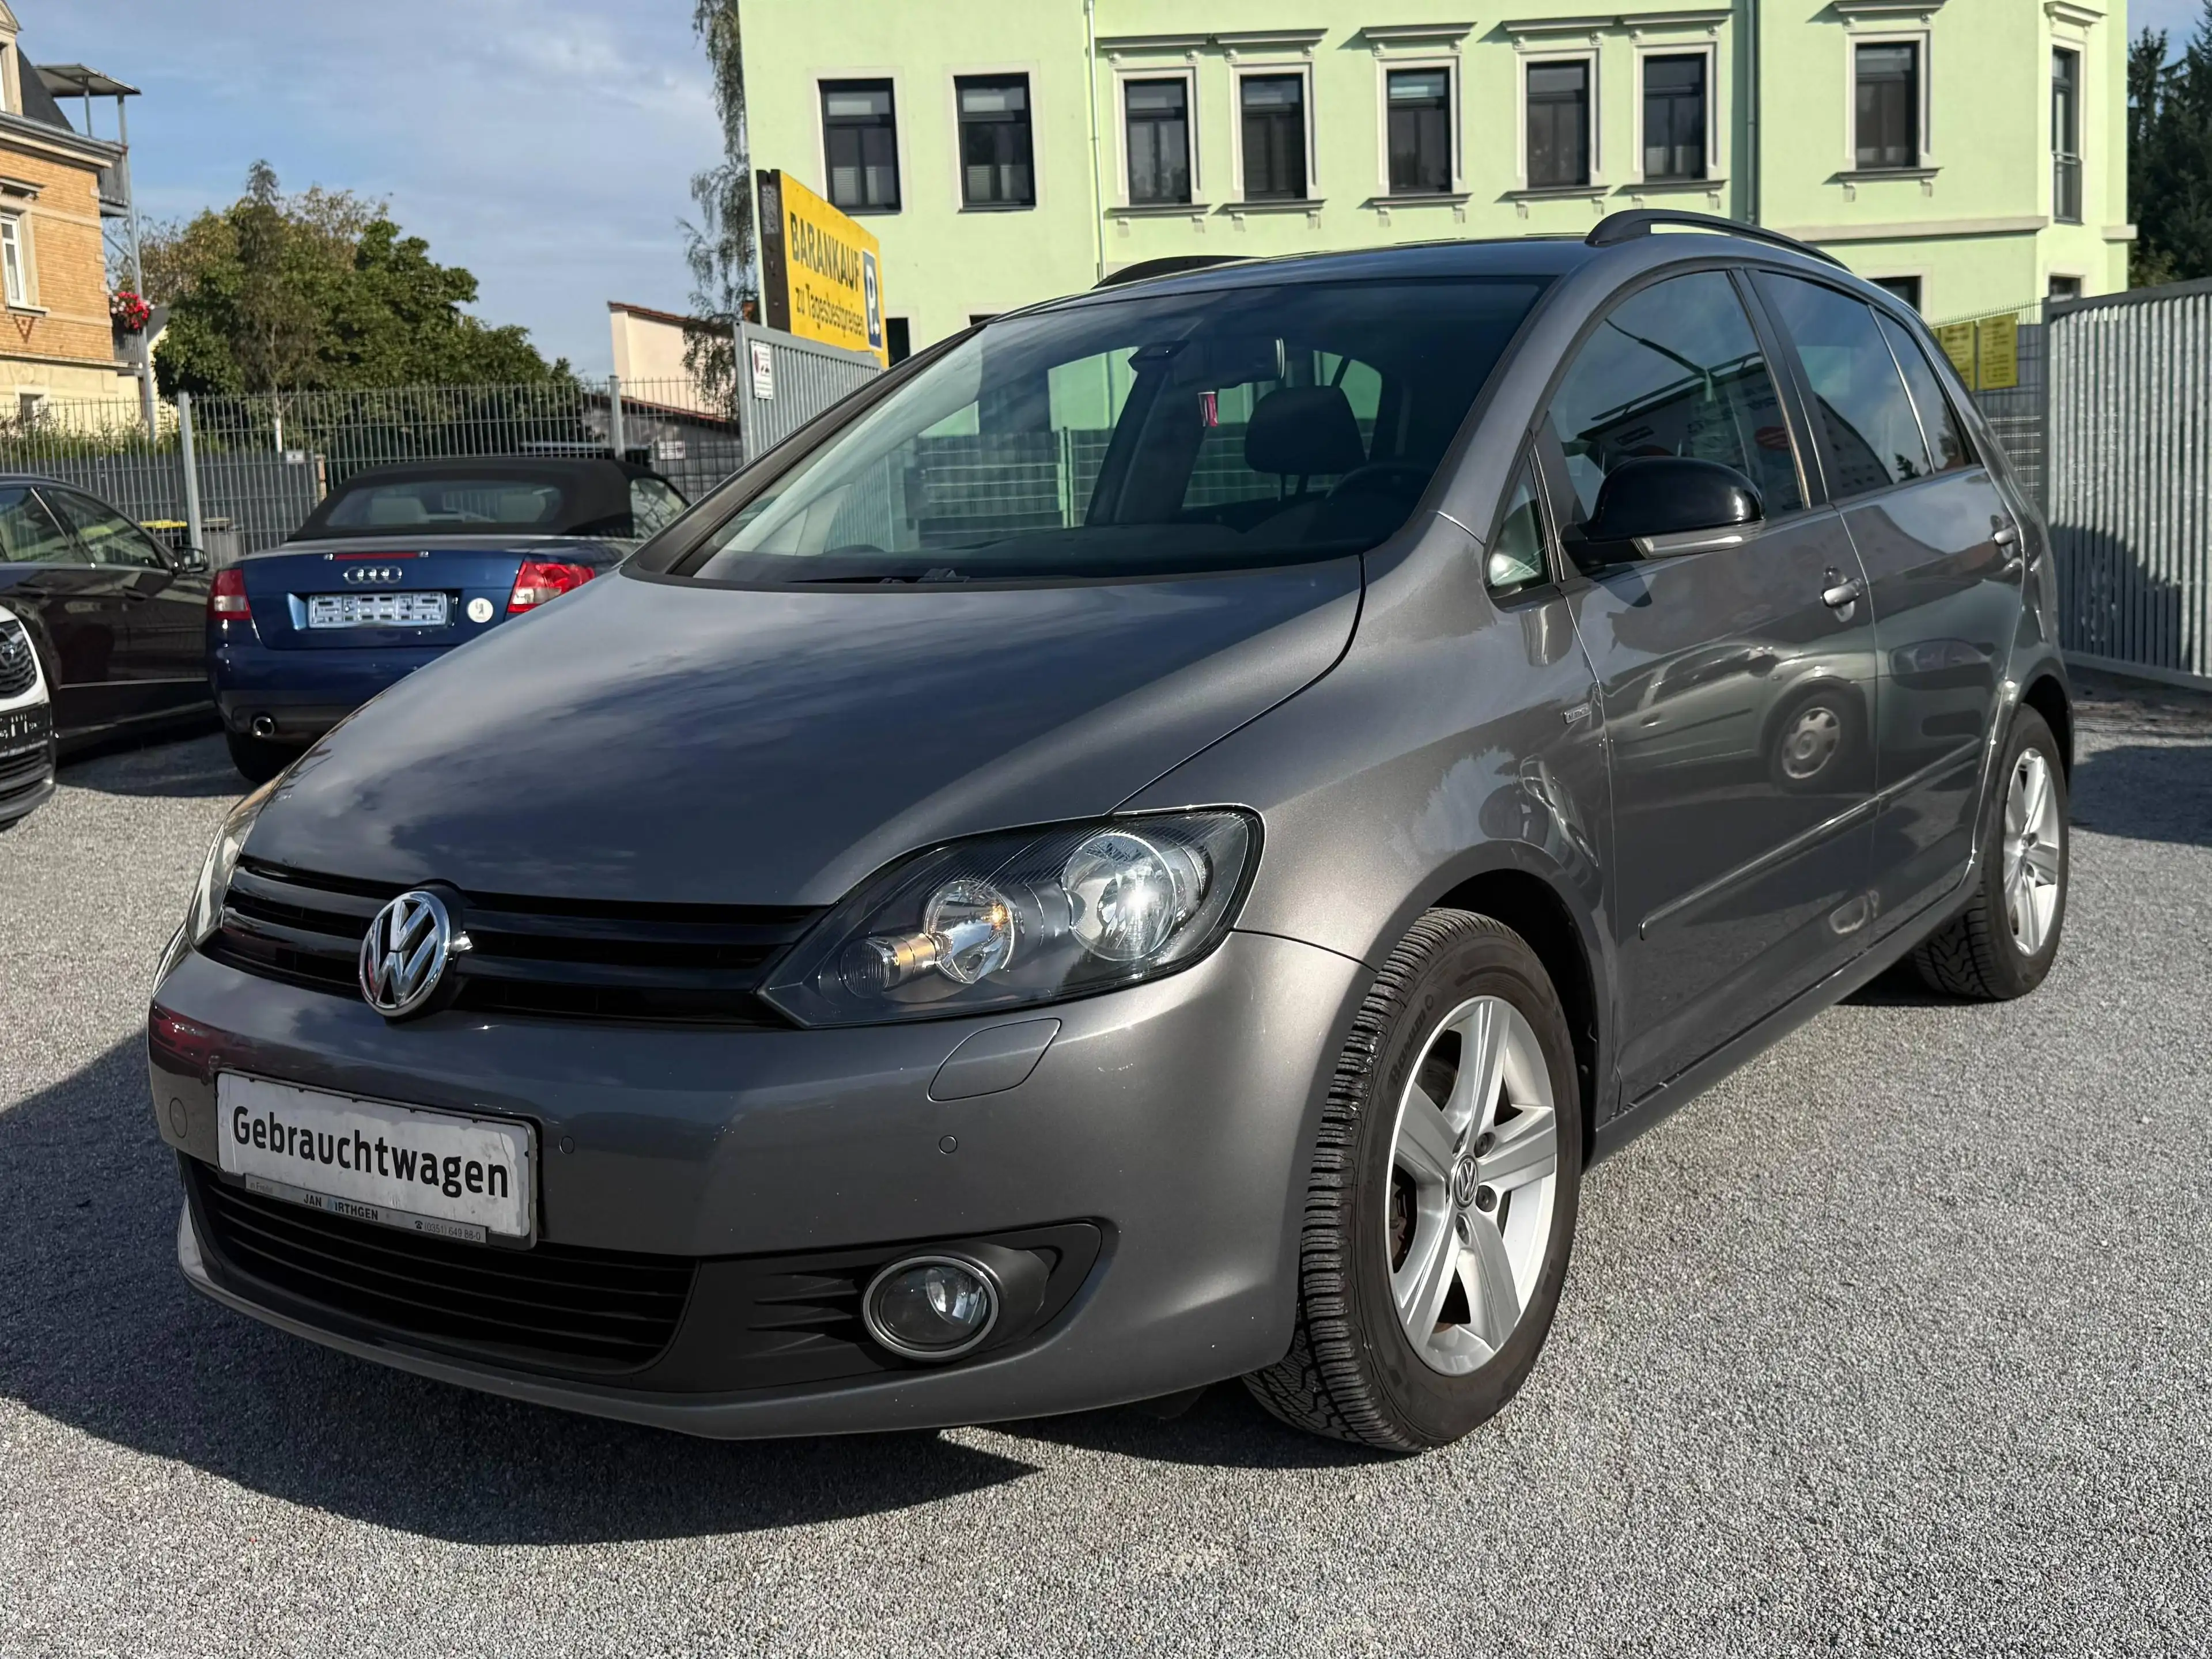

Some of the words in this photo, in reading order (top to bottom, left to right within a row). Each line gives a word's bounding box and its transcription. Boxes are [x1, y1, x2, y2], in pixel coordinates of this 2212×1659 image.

[790, 211, 859, 292] BARANKAUF
[233, 1105, 509, 1199] Gebrauchtwagen
[304, 1194, 322, 1207] JAN
[425, 1222, 447, 1235] (0351)
[448, 1226, 462, 1237] 649
